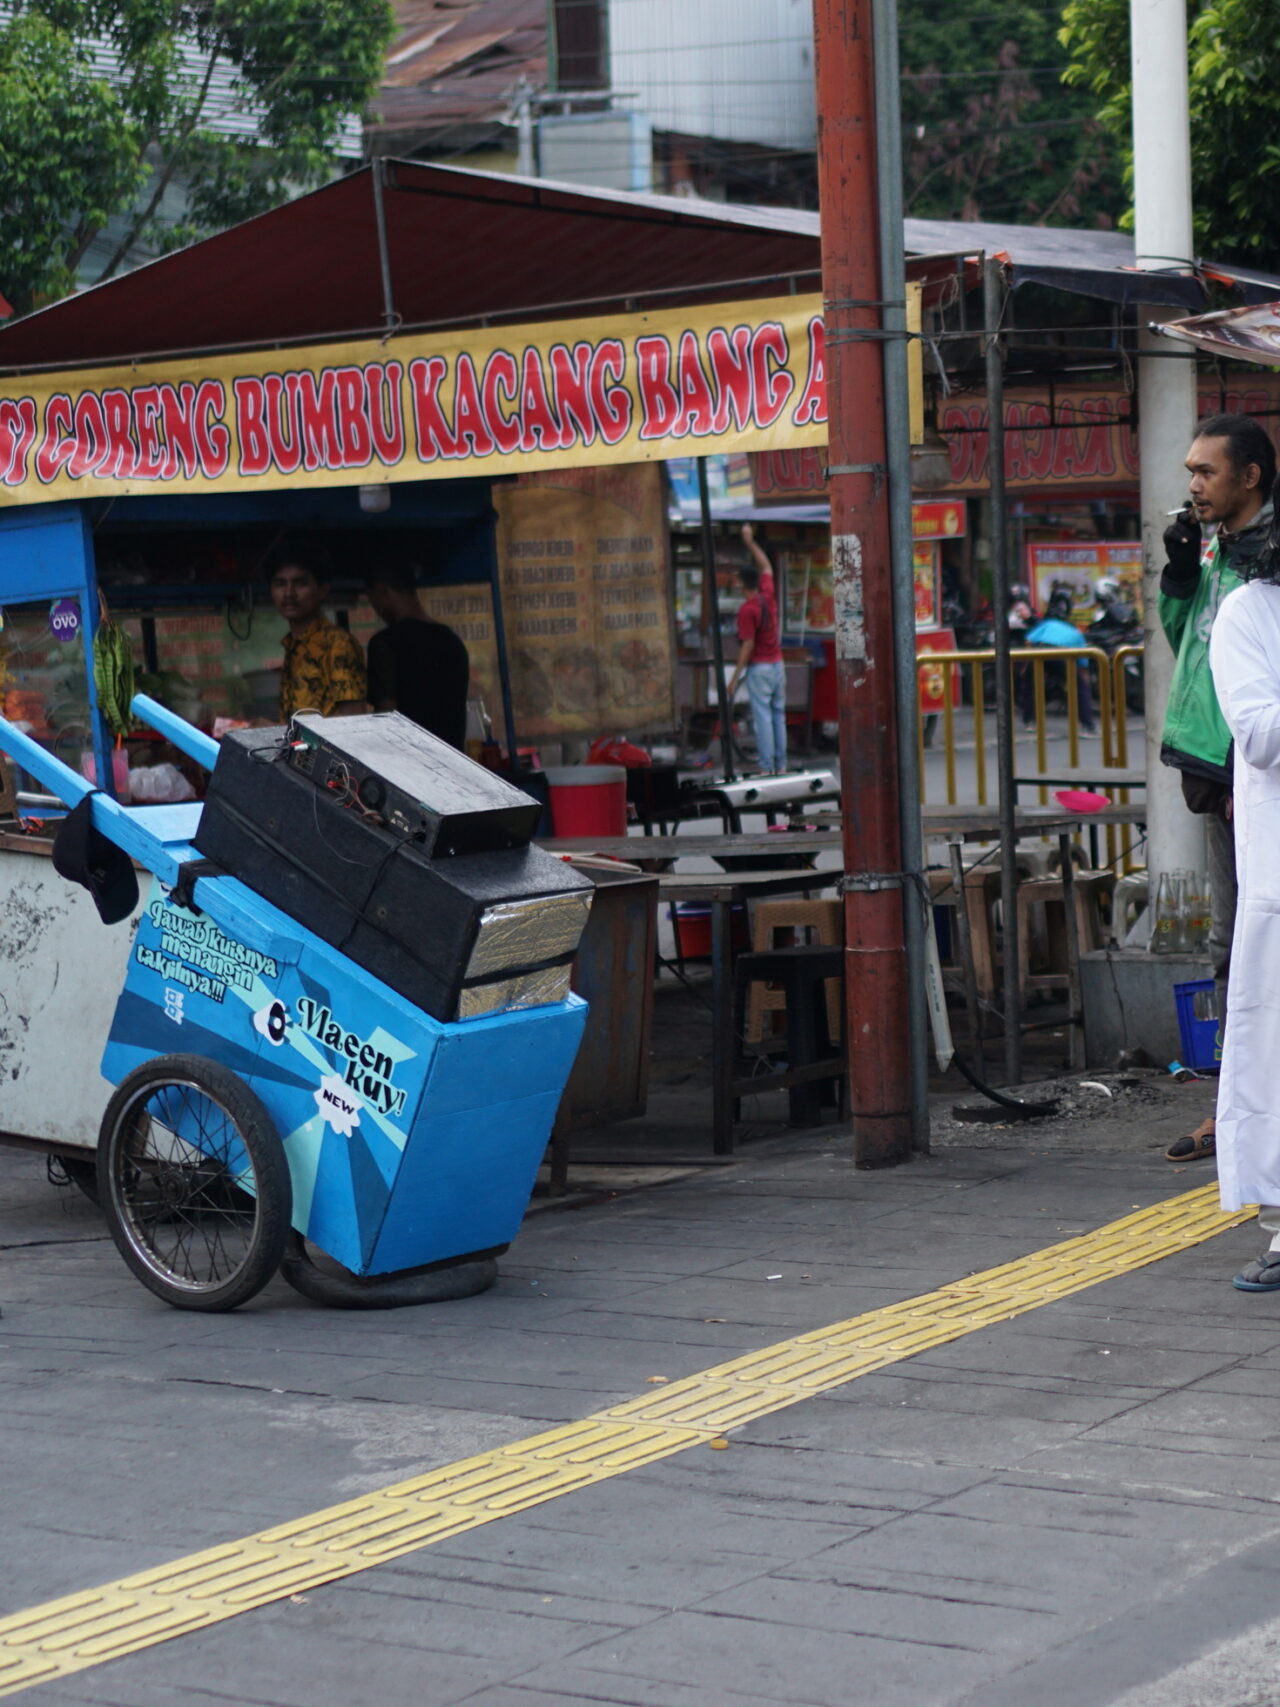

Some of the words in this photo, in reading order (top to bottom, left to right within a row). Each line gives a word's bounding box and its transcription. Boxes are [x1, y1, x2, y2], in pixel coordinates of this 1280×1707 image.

[36, 380, 230, 484] GORENG
[233, 361, 404, 476] BUMBU
[410, 338, 633, 463] KACANG
[636, 322, 794, 441] BANG
[53, 612, 78, 630] OVO
[160, 931, 254, 992] menangin
[207, 927, 279, 978] kuisnya
[298, 998, 394, 1081] Maeen
[323, 1089, 355, 1115] NEW
